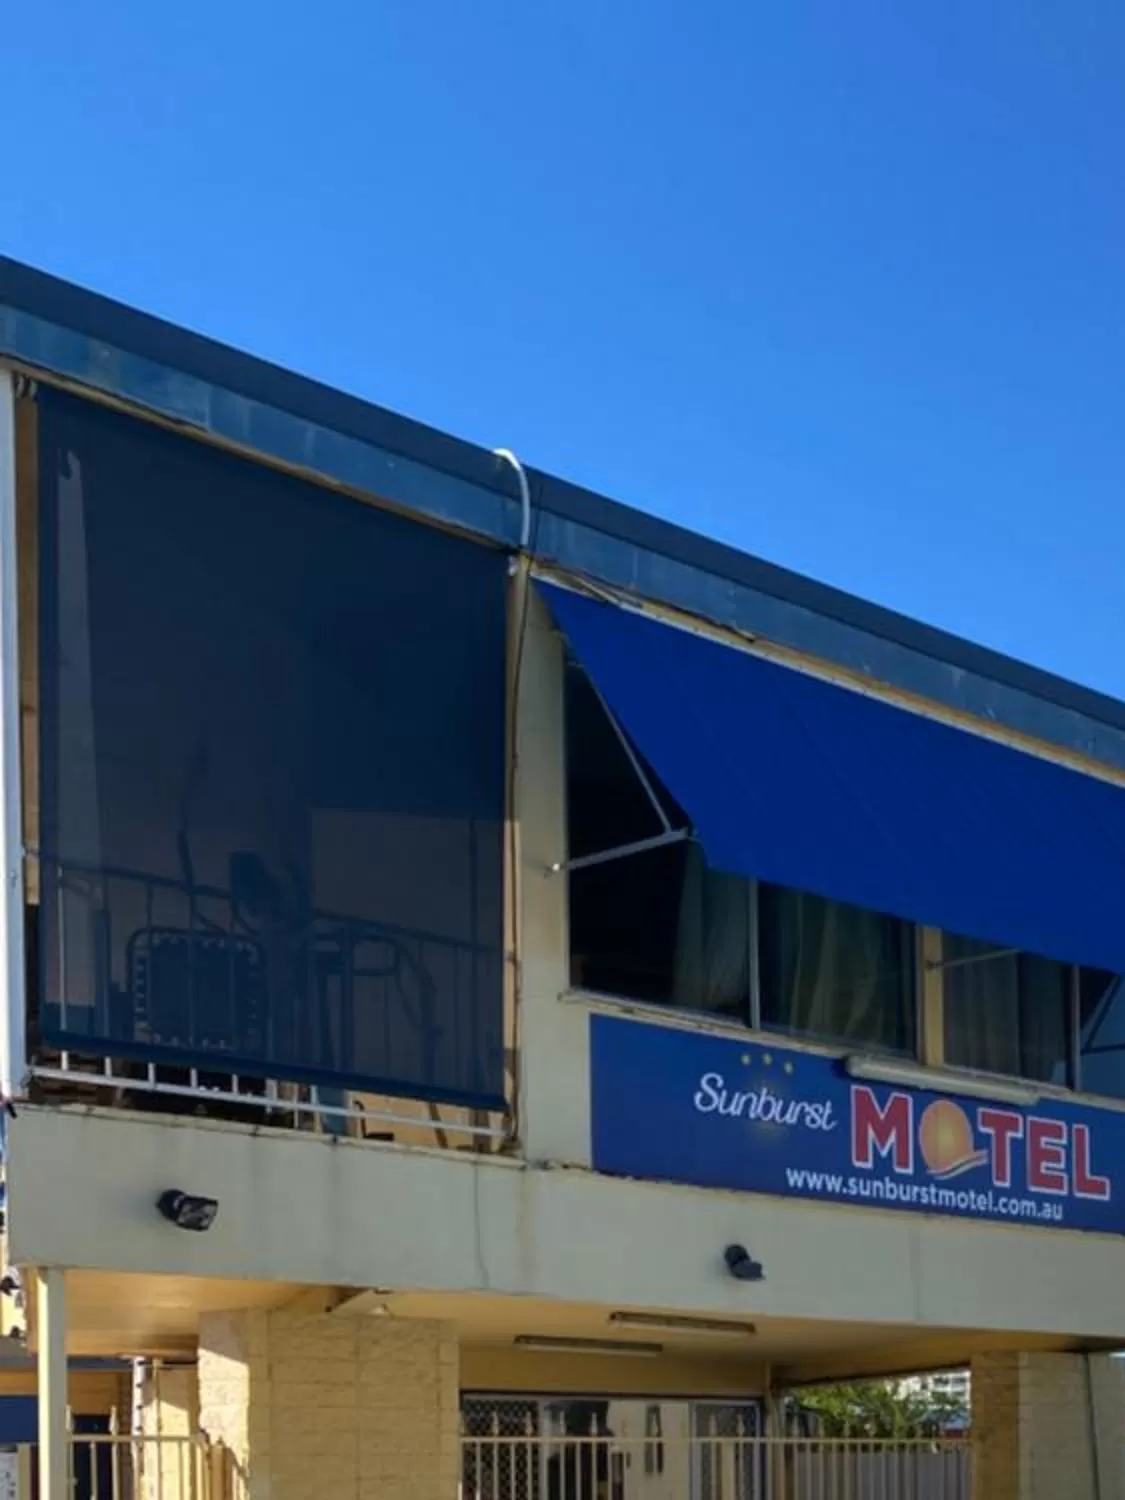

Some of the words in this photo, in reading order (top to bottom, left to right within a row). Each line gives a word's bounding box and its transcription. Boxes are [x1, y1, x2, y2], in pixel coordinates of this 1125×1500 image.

[694, 1073, 837, 1131] Sunburst
[850, 1084, 1110, 1200] MOTEL
[786, 1166, 1063, 1221] www.sunburstmotel.com.au
